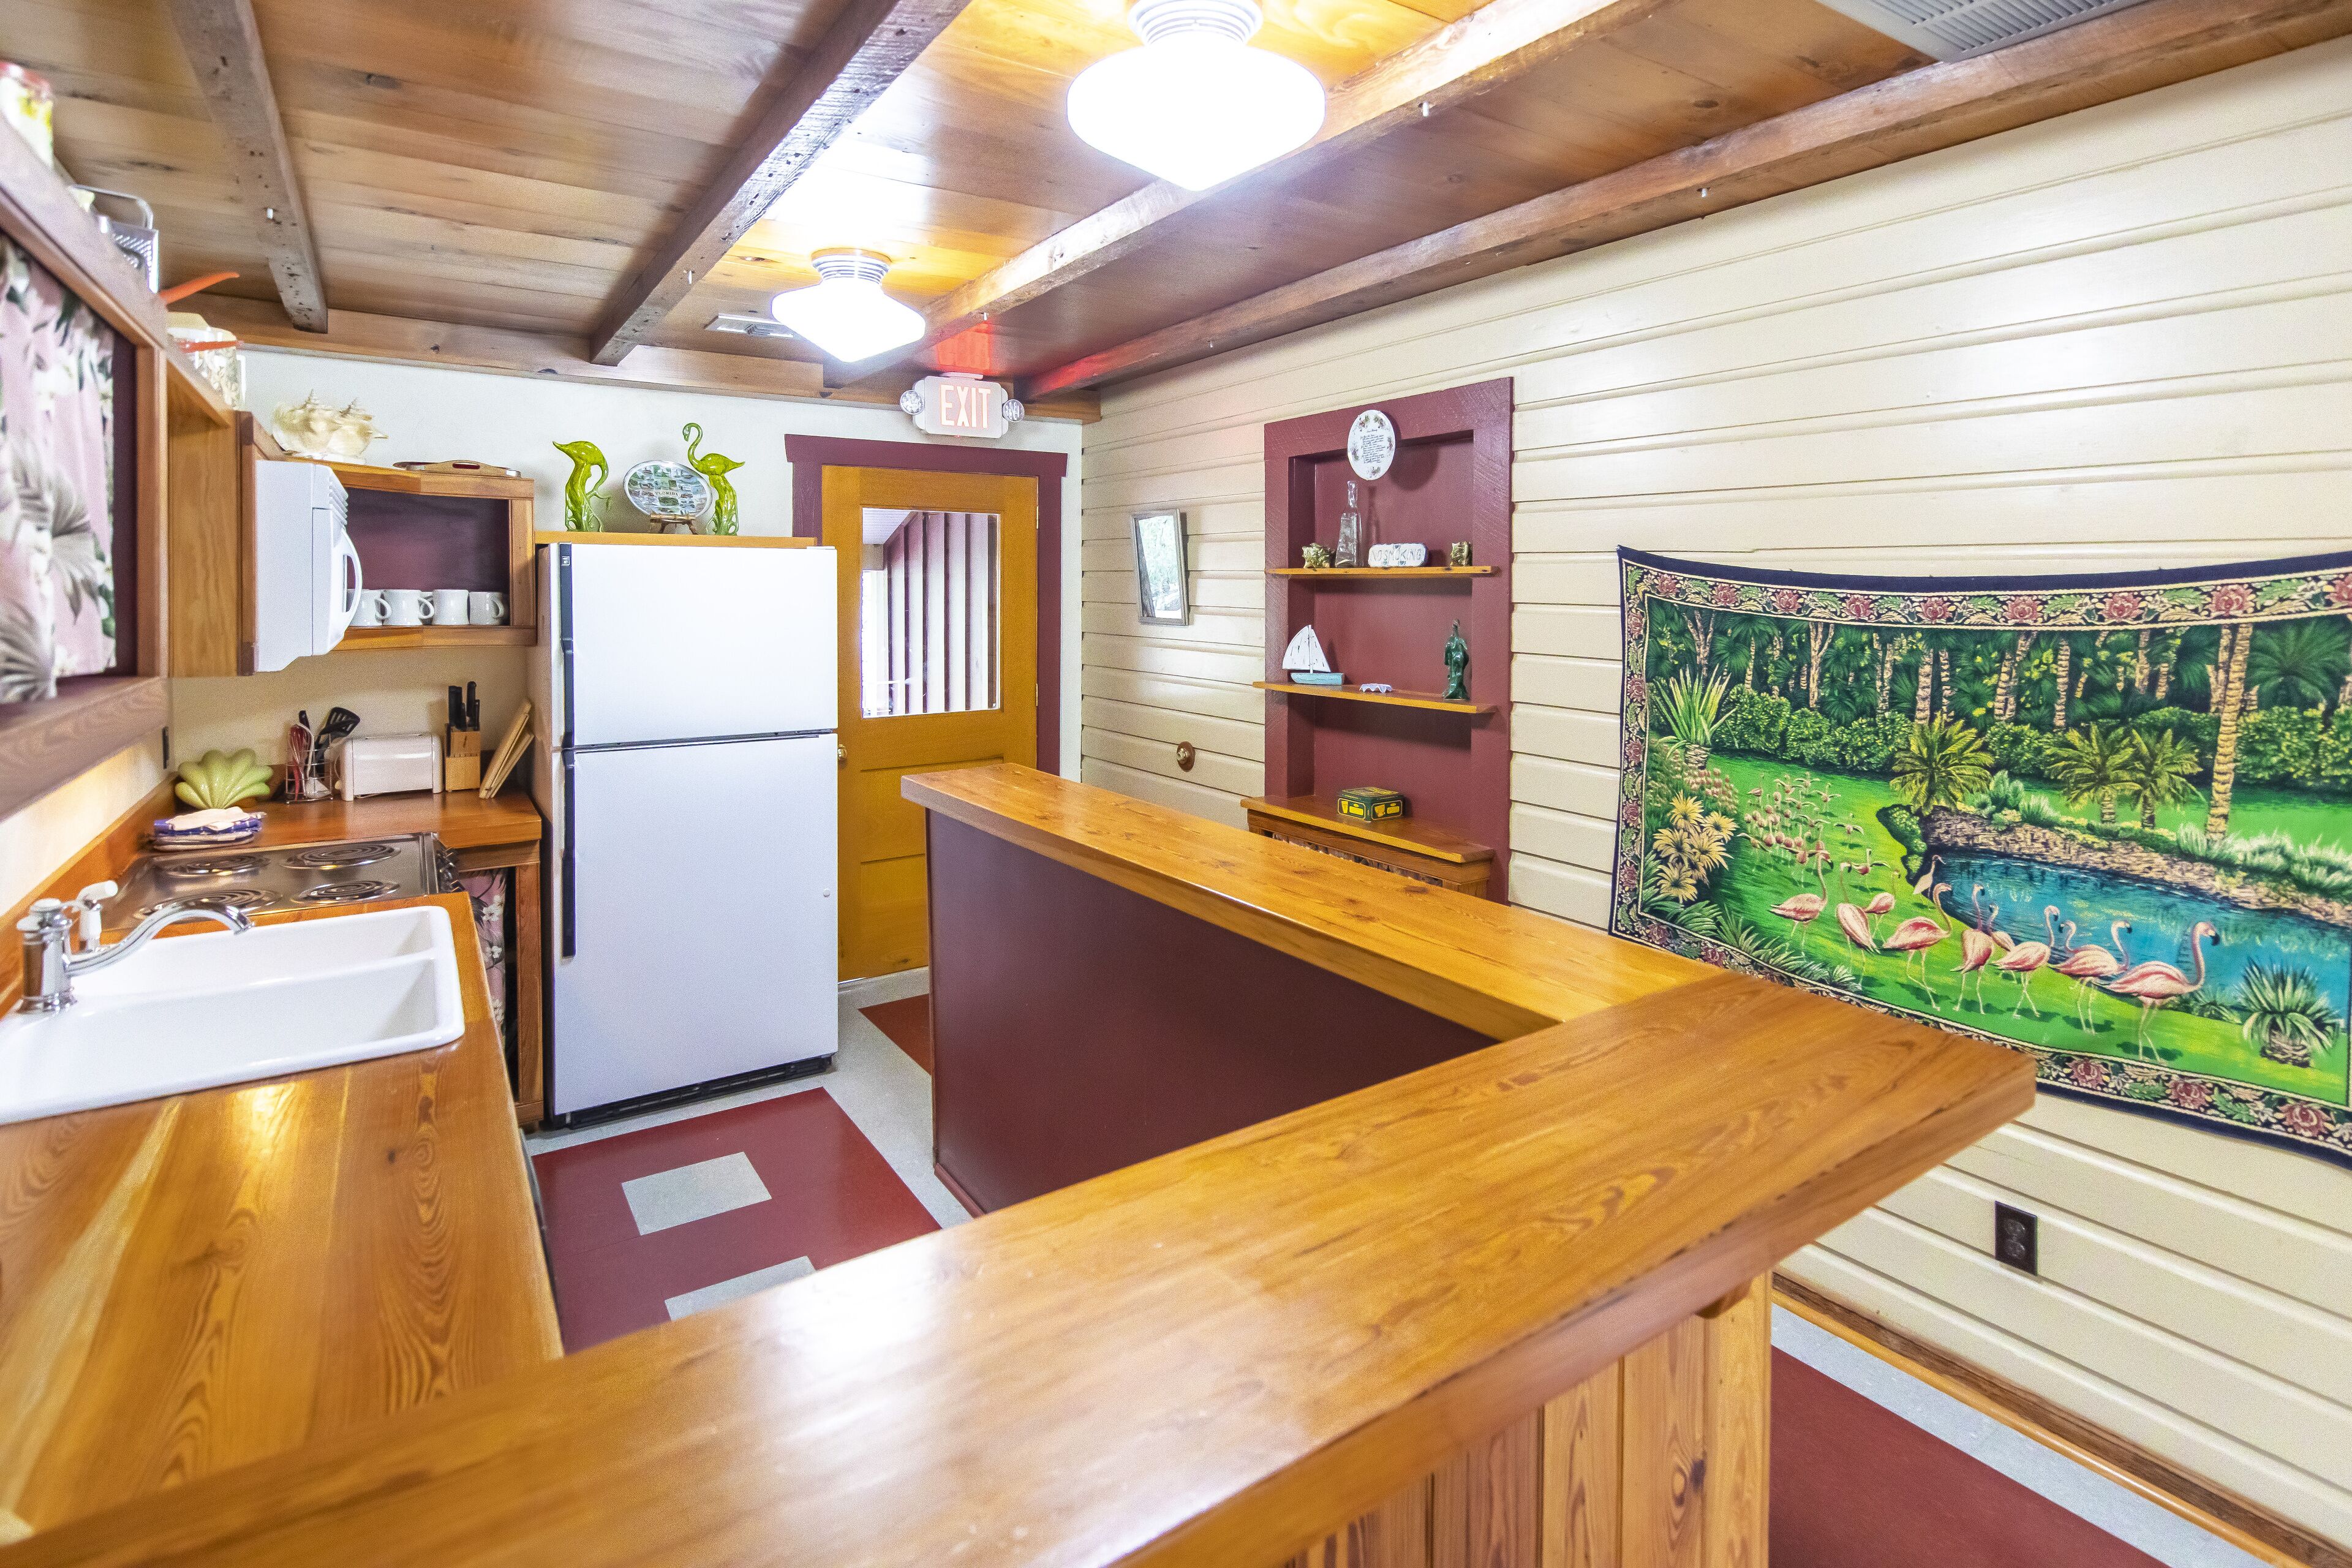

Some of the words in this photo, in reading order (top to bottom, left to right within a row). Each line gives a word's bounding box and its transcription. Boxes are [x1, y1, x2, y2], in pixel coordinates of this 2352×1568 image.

[940, 384, 991, 429] EXIT
[1372, 549, 1382, 561] NO
[1384, 549, 1422, 562] SMOKING
